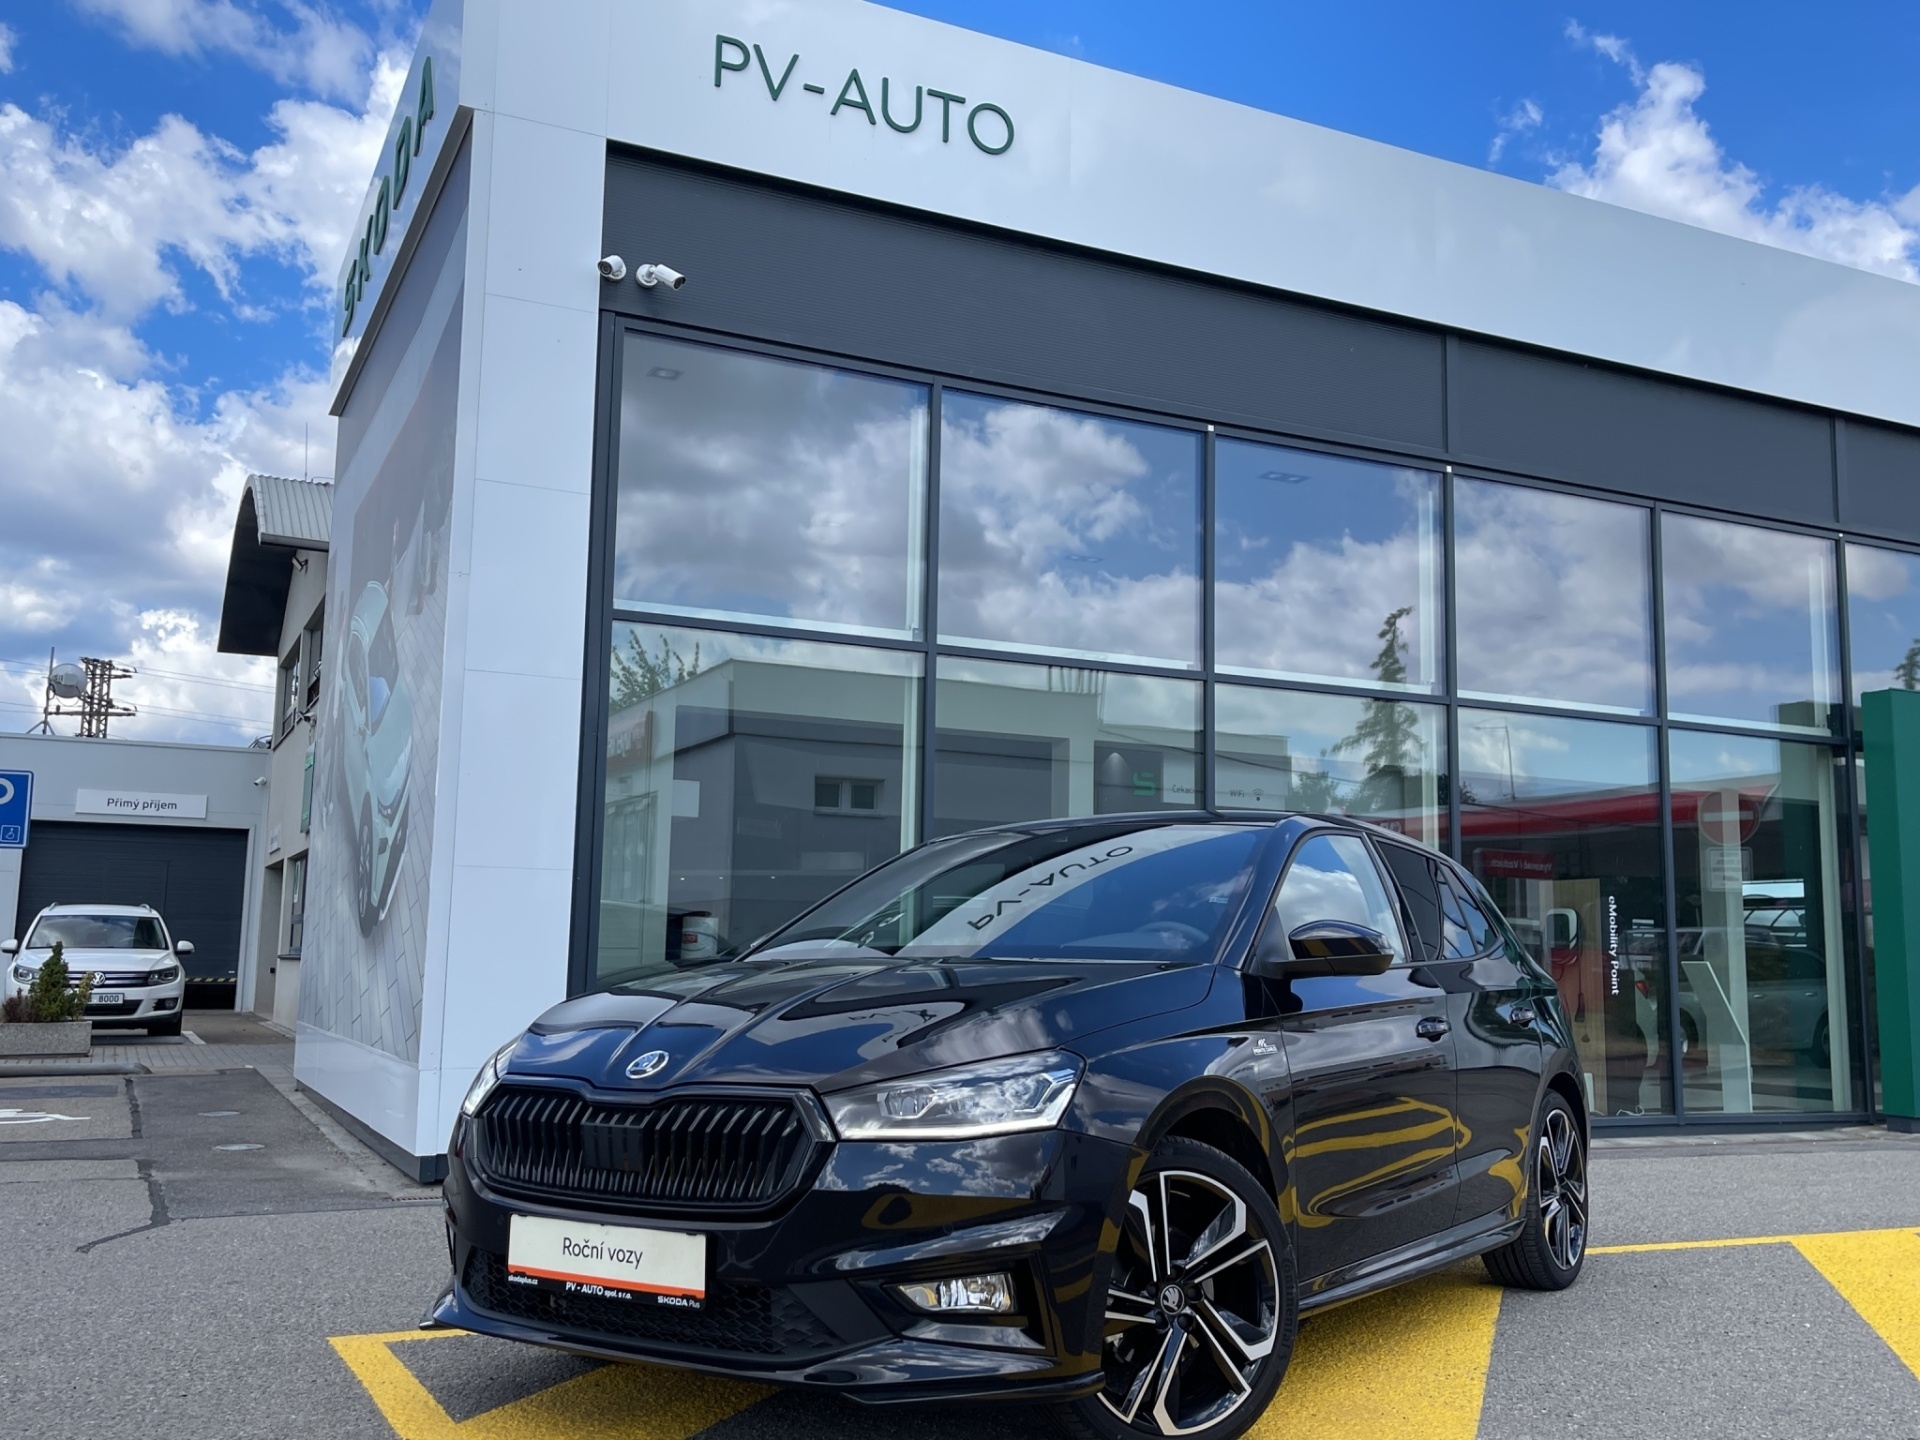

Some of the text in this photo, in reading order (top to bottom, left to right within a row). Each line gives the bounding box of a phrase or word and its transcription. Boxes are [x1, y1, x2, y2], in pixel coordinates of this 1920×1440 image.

[714, 34, 1015, 156] PV-AUTO
[1608, 895, 1621, 996] eMobility Point
[98, 994, 120, 1003] 8000
[562, 1236, 643, 1269] Roční vozy
[566, 1281, 577, 1292] PV
[581, 1283, 604, 1296] AUTO
[604, 1289, 618, 1298] spol.
[623, 1292, 633, 1300] r.o.
[688, 1299, 701, 1309] Plus
